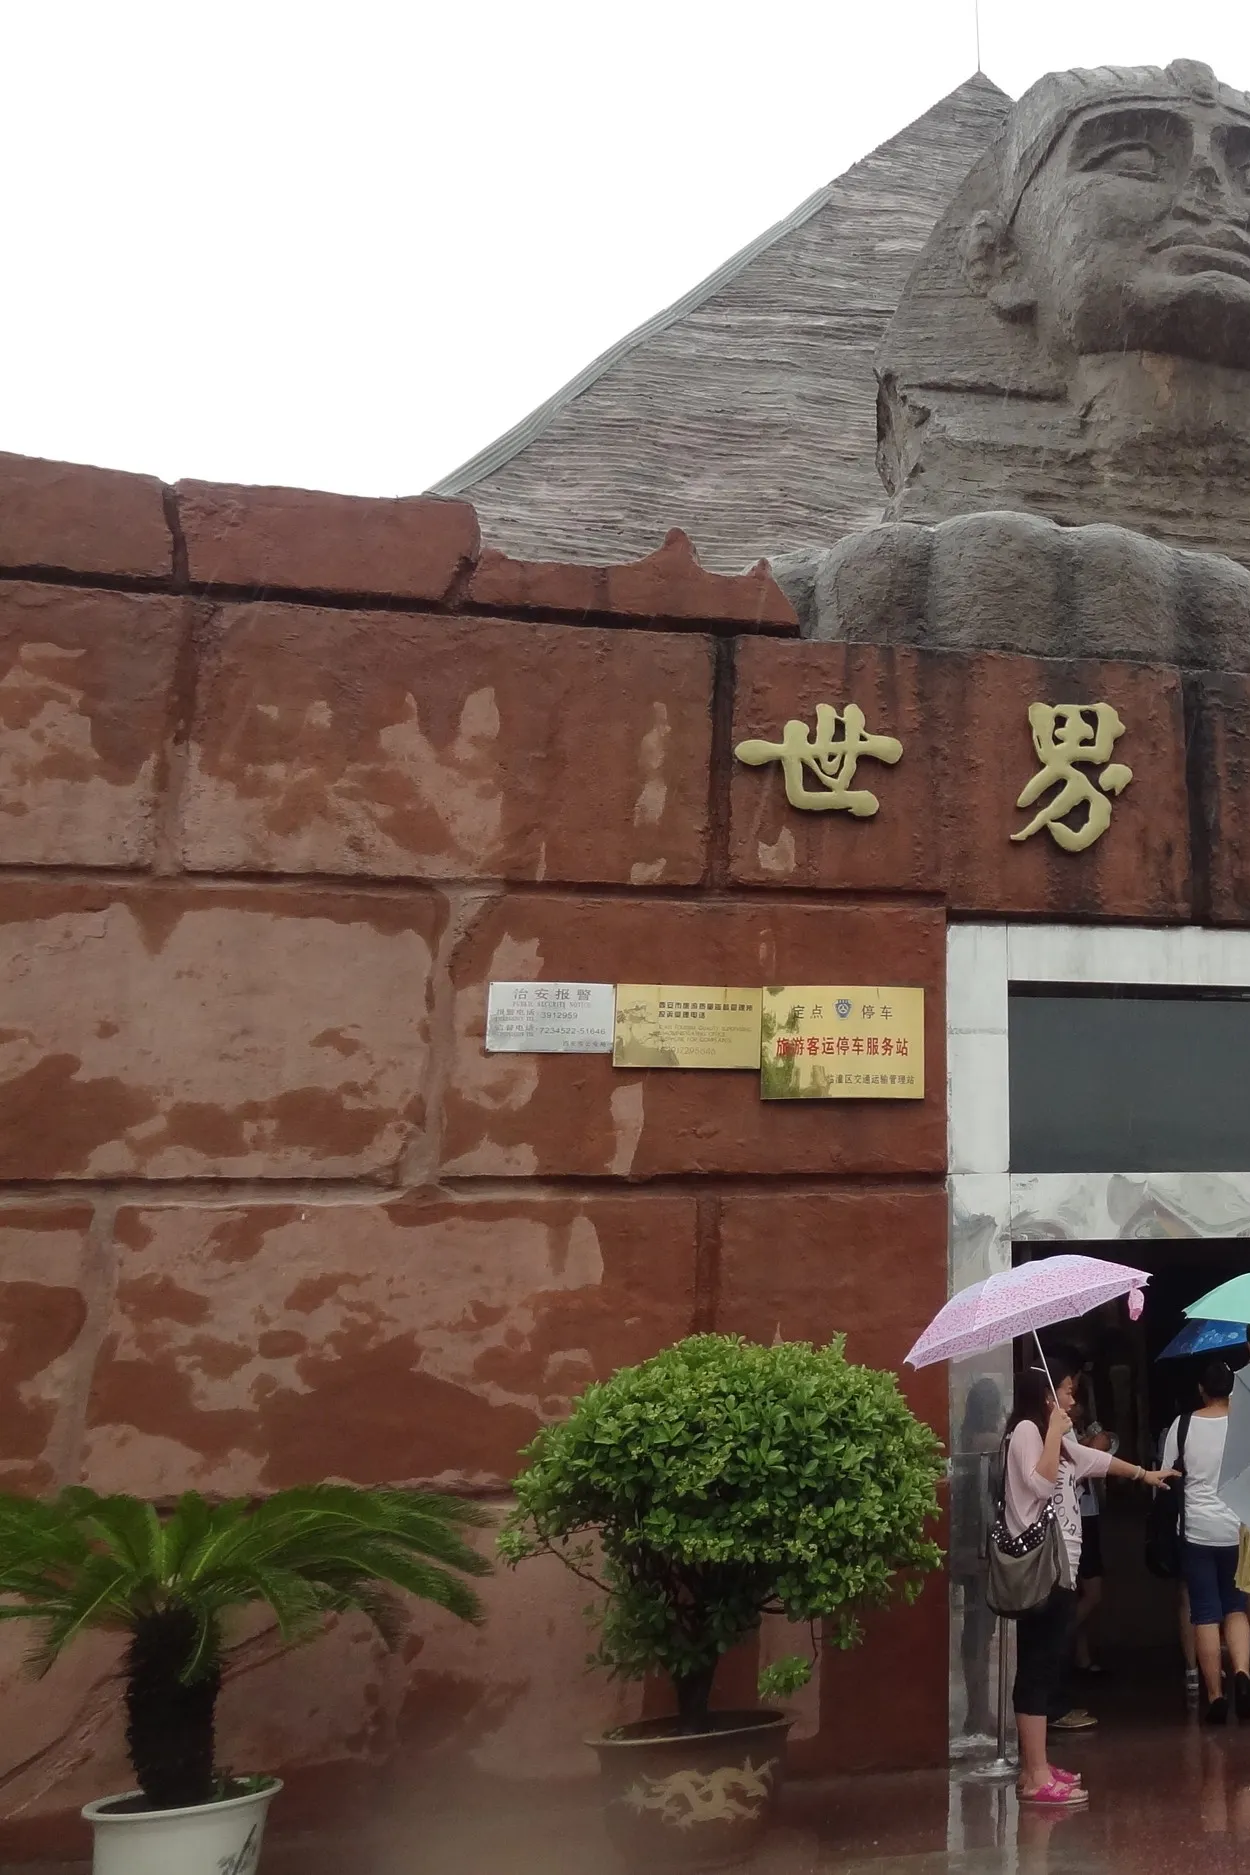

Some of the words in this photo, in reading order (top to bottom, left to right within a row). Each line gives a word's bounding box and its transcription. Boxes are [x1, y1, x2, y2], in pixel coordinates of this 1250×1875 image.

[513, 988, 592, 1001] 治安报警
[540, 1011, 578, 1019] 3912959
[793, 1004, 824, 1019] 定点
[861, 1004, 893, 1020] 停车
[776, 1036, 909, 1057] 旅游客运停车服务站
